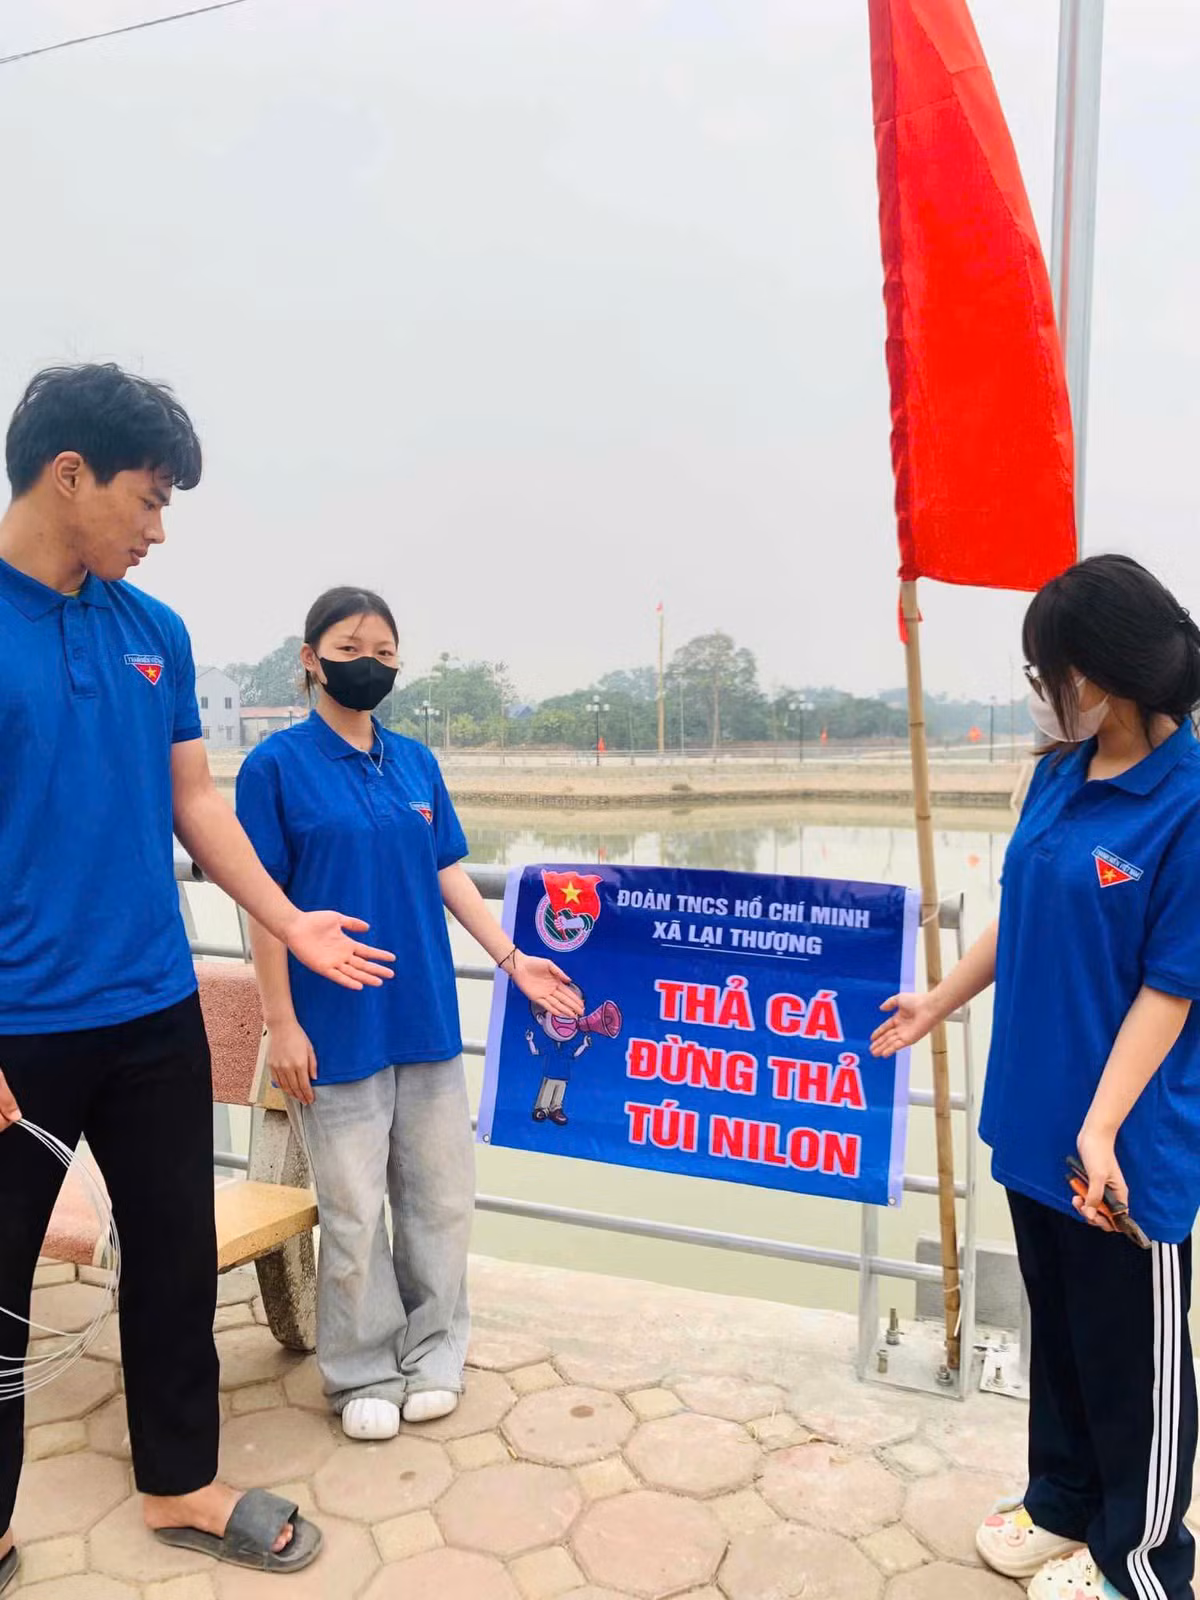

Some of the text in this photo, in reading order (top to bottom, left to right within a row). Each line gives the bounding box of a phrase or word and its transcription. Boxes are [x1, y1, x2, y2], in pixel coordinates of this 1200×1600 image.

[617, 888, 671, 911] ĐOÀN
[676, 894, 729, 916] TNCS
[768, 901, 805, 923] CHÍ
[810, 905, 870, 929] MINH
[652, 919, 823, 956] XÃ LẠI THƯỢNG
[655, 975, 844, 1043] THẢ CÁ
[626, 1034, 867, 1110] ĐỪNG THẢ
[624, 1099, 862, 1179] TÚI NILON
